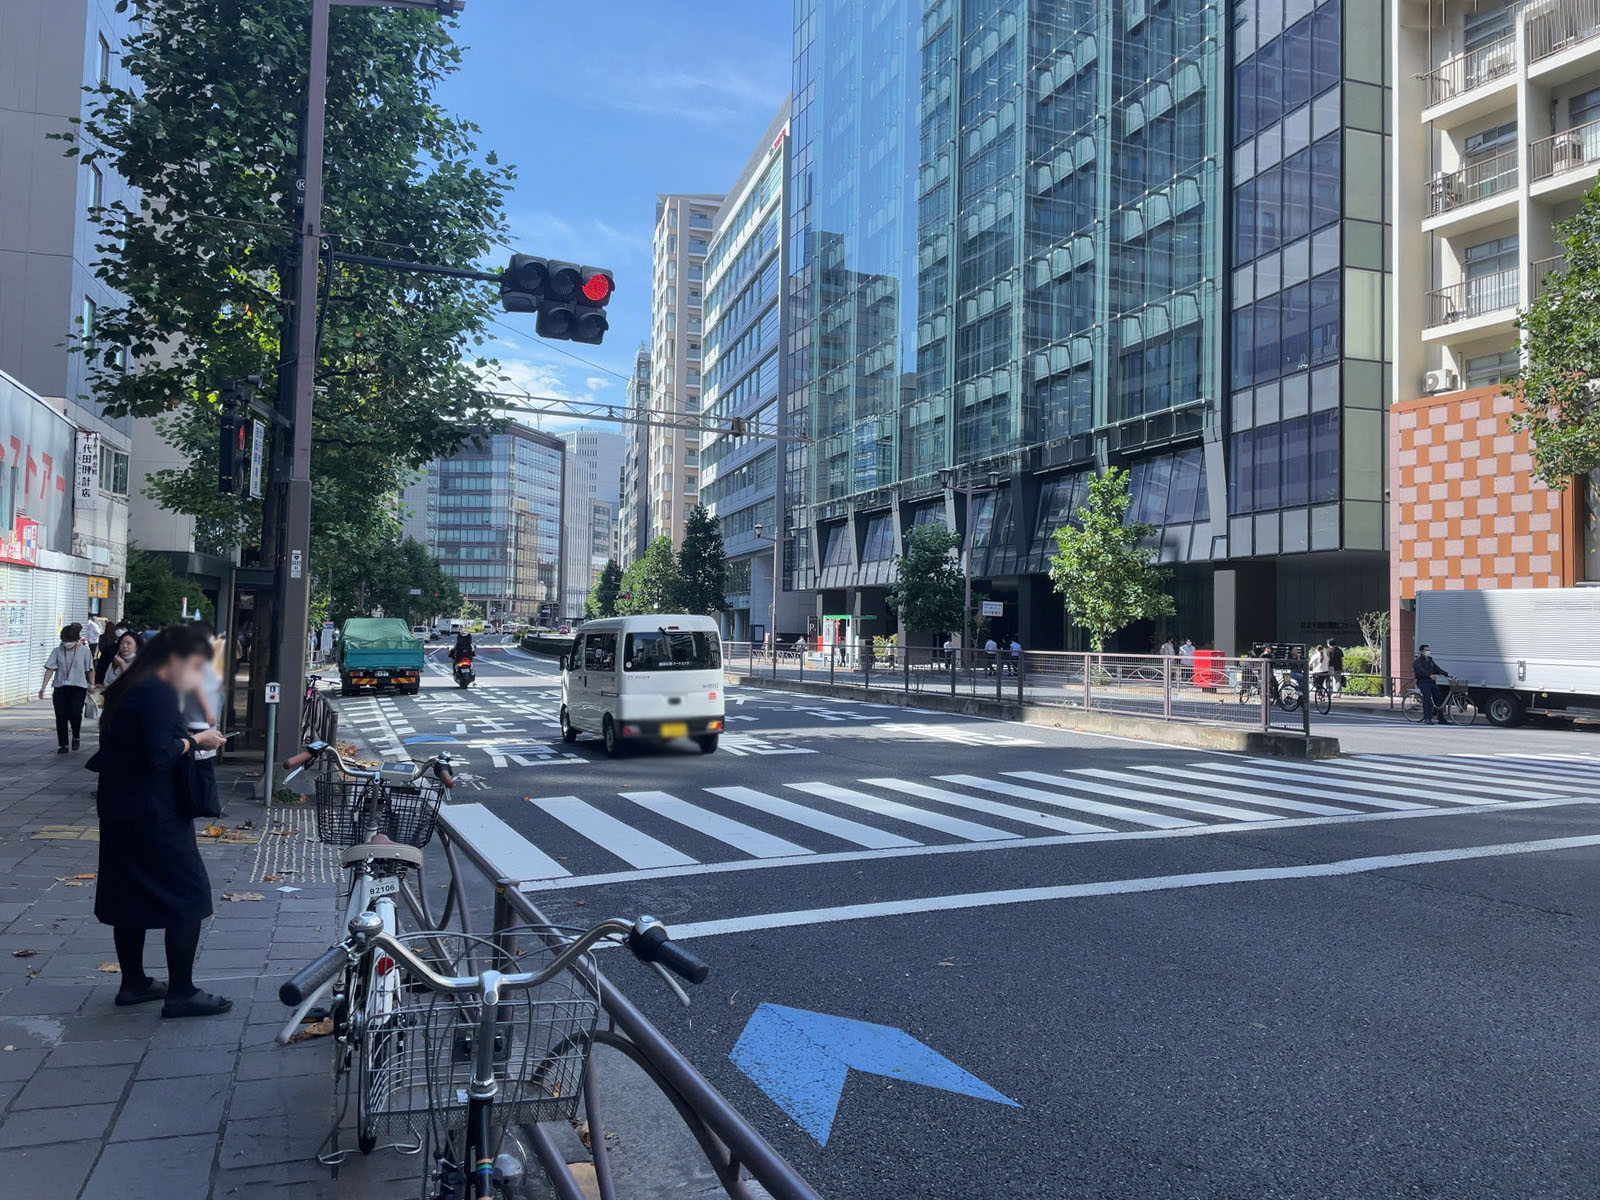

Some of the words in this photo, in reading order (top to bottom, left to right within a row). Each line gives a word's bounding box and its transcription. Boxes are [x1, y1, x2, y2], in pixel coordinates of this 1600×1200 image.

[0, 435, 66, 499] ストアー
[81, 433, 92, 498] 千代田時計店
